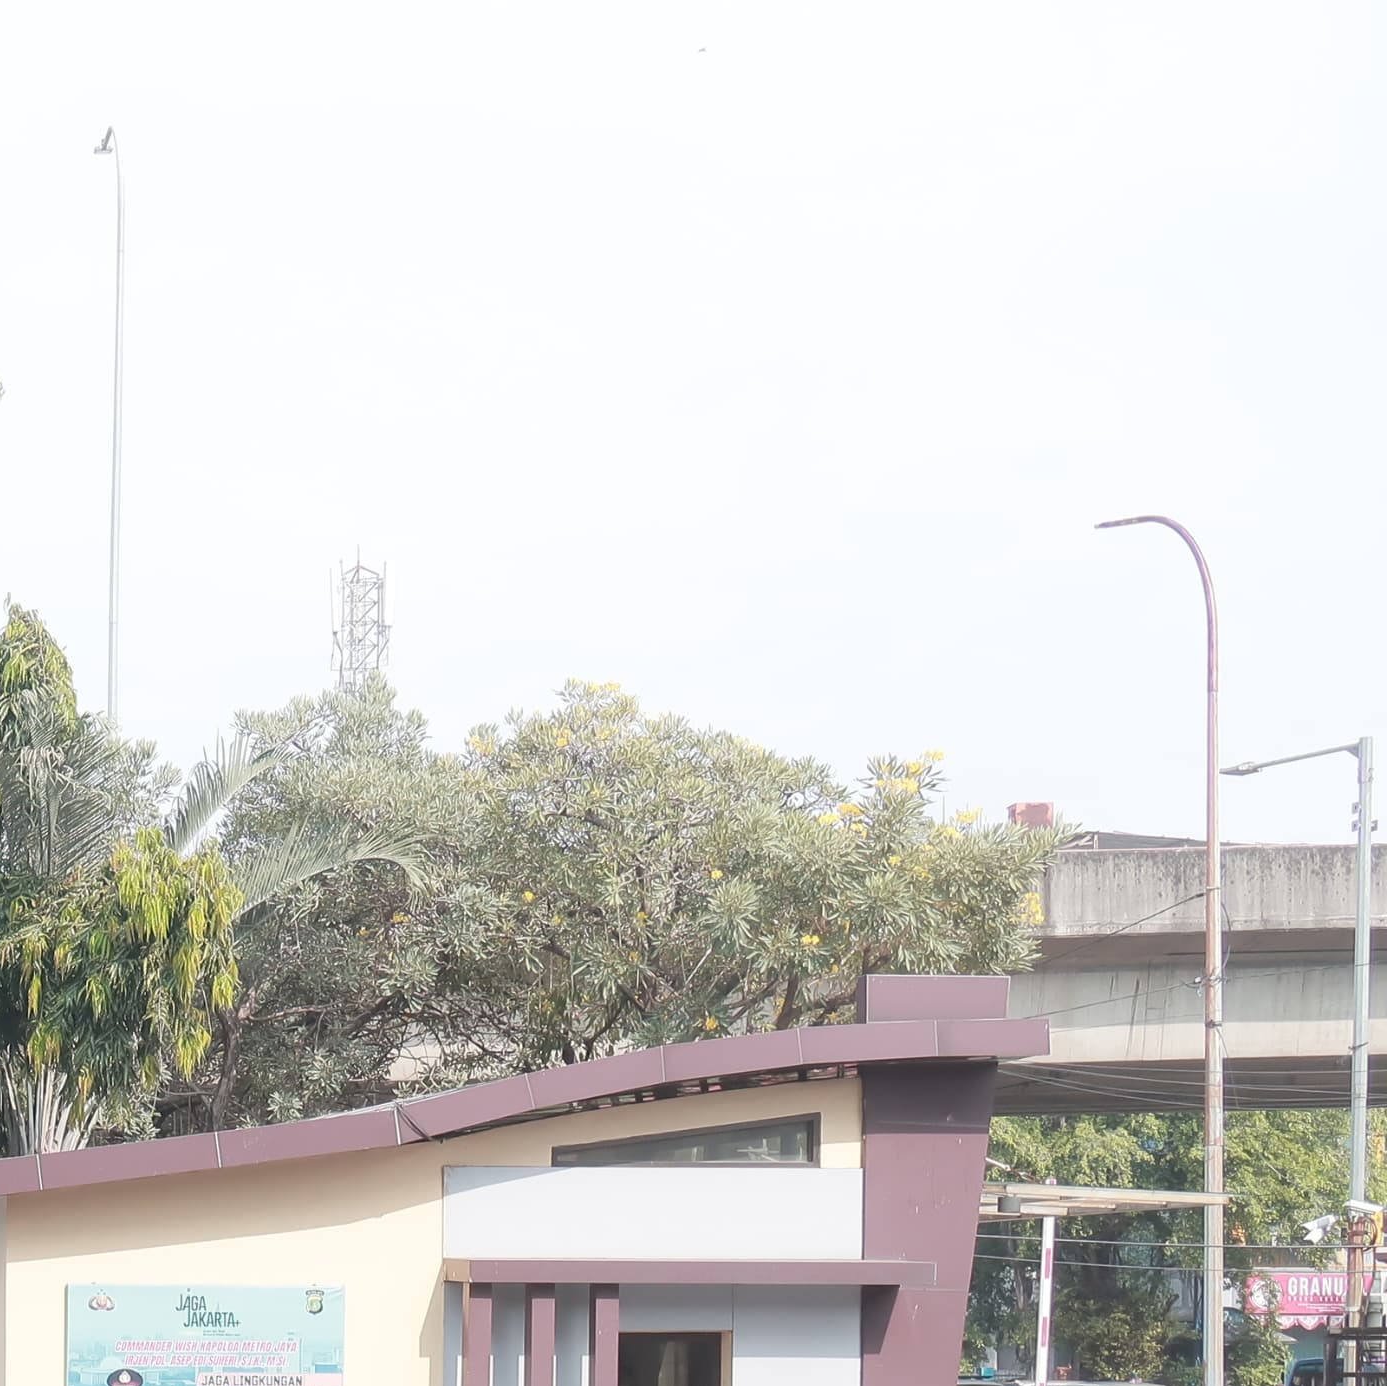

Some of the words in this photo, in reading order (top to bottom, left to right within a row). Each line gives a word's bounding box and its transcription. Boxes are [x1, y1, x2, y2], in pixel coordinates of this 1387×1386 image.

[175, 1293, 207, 1312] JAGA
[115, 1341, 173, 1352] COMMANDER
[175, 1341, 198, 1352] WISH
[199, 1341, 239, 1352] KAPOLDA
[241, 1341, 272, 1352] METRO
[274, 1341, 298, 1352] JAYA
[124, 1355, 150, 1366] IRJEN
[170, 1355, 192, 1366] ASEP
[193, 1355, 208, 1366] EDI
[201, 1375, 229, 1386] JAGA
[233, 1375, 303, 1386] LINGKUNGAN
